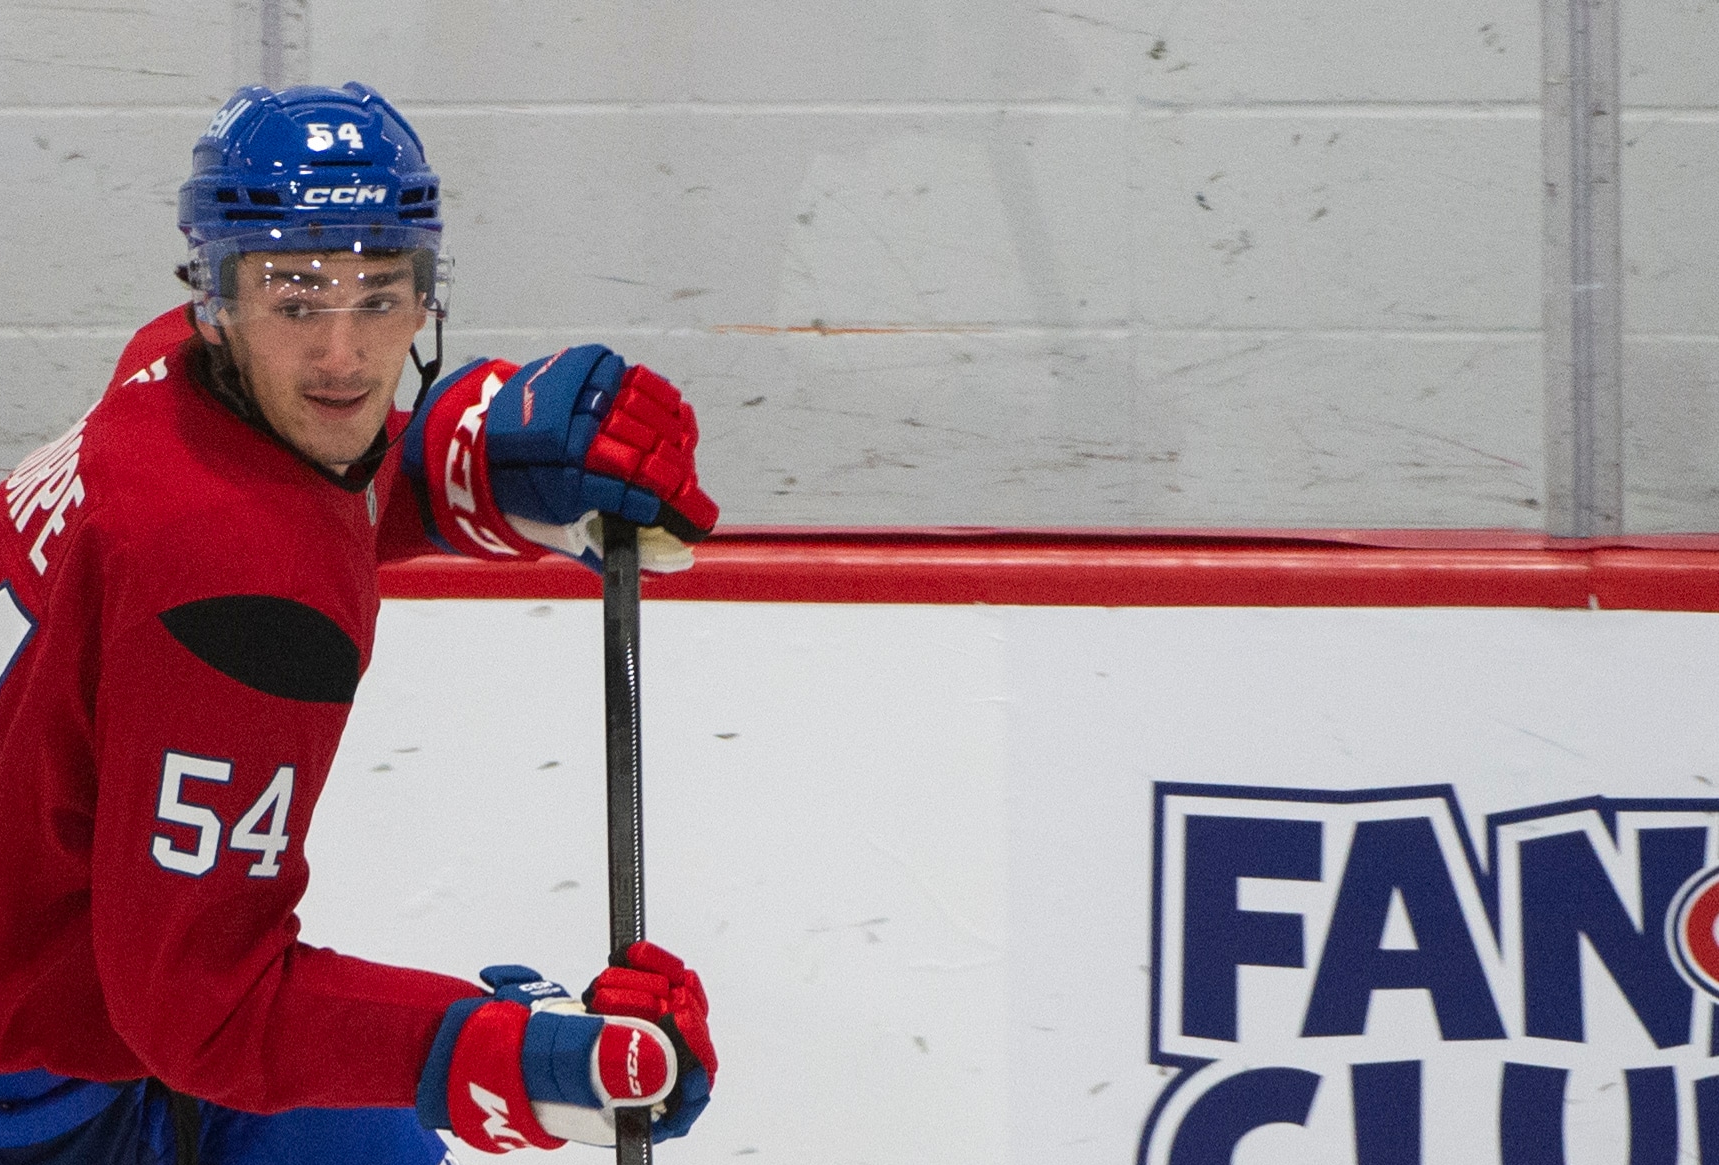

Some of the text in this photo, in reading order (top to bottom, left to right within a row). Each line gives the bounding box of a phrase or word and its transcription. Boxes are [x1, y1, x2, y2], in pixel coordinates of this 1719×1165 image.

[307, 122, 364, 151] 54
[304, 186, 387, 204] CCM
[150, 749, 296, 878] 54
[1177, 812, 1698, 1052] FAN
[626, 1028, 642, 1097] CCM
